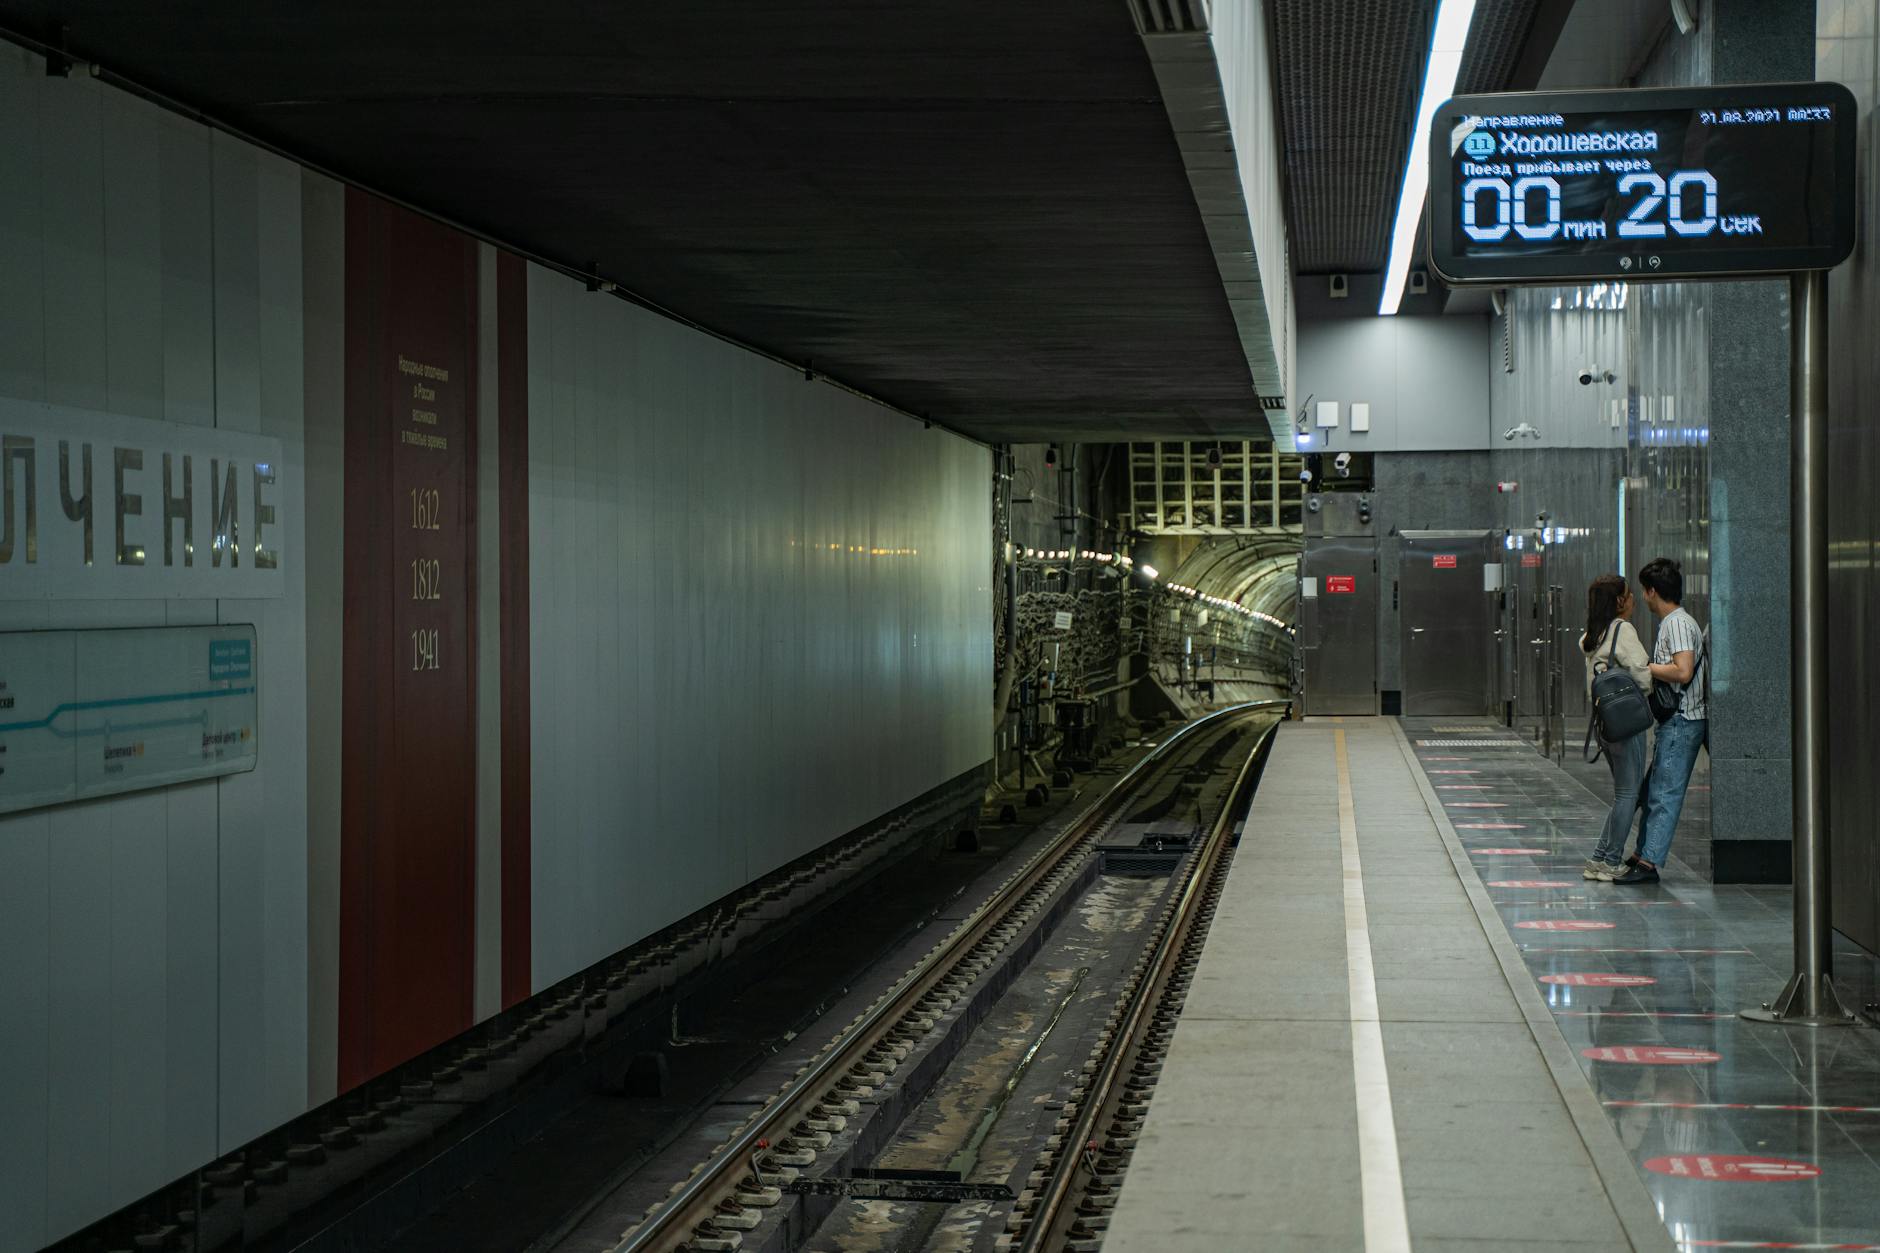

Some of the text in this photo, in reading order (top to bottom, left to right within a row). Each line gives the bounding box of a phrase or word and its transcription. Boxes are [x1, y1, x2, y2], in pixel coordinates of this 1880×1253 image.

[1464, 114, 1564, 128] Направление
[1463, 158, 1651, 176] Поезд прибывает через
[1463, 170, 1763, 241] 00 мин 20 сек
[411, 487, 440, 530] 1612
[411, 558, 440, 601] 1812
[411, 629, 440, 671] 1941
